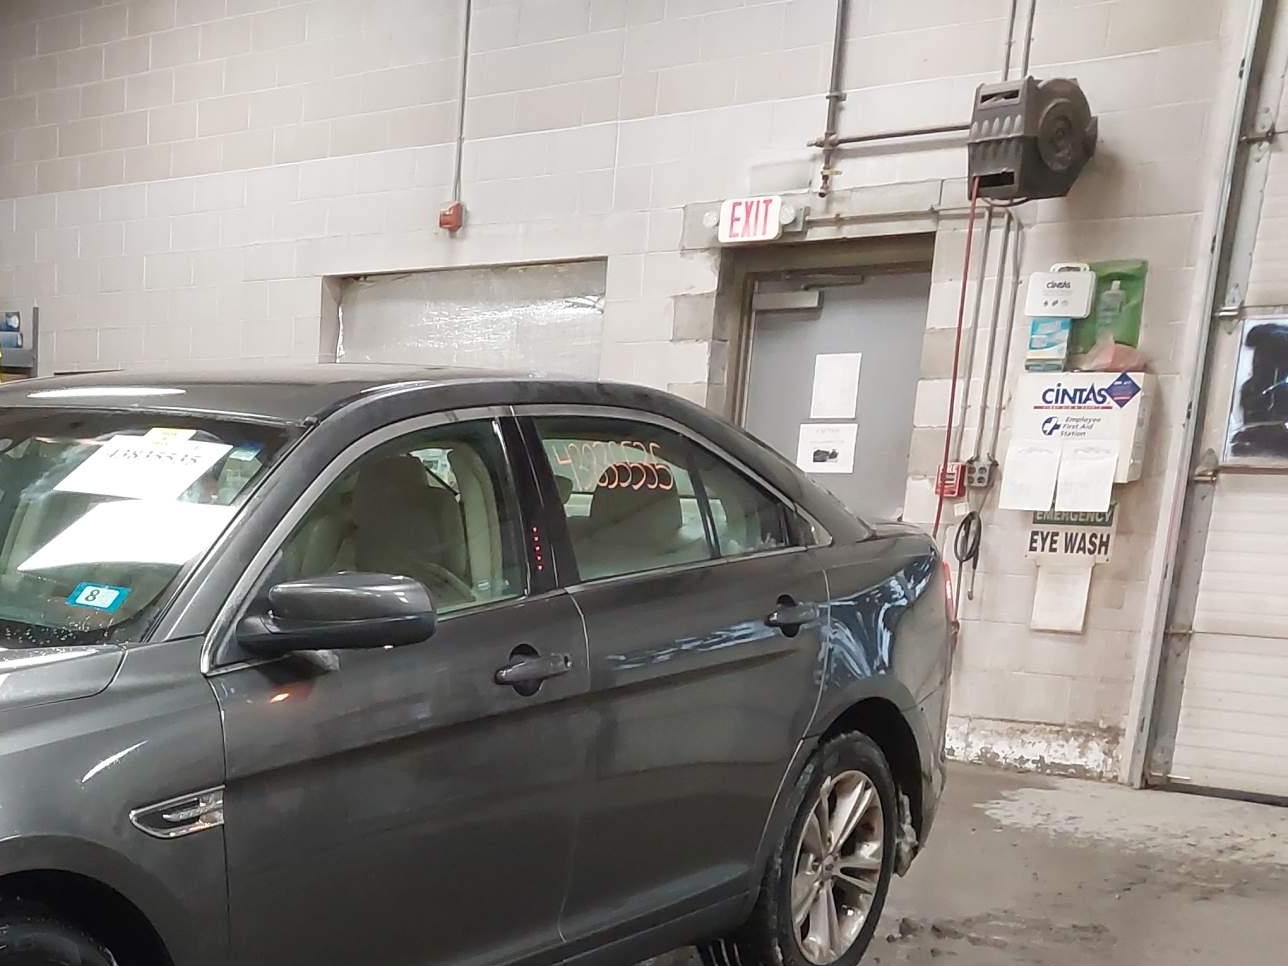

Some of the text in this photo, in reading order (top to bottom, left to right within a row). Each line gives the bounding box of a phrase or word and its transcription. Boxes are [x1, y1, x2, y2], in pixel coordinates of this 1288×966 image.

[729, 199, 773, 238] EXIT
[1065, 416, 1101, 425] Employee
[1029, 530, 1111, 555] EYE WASH
